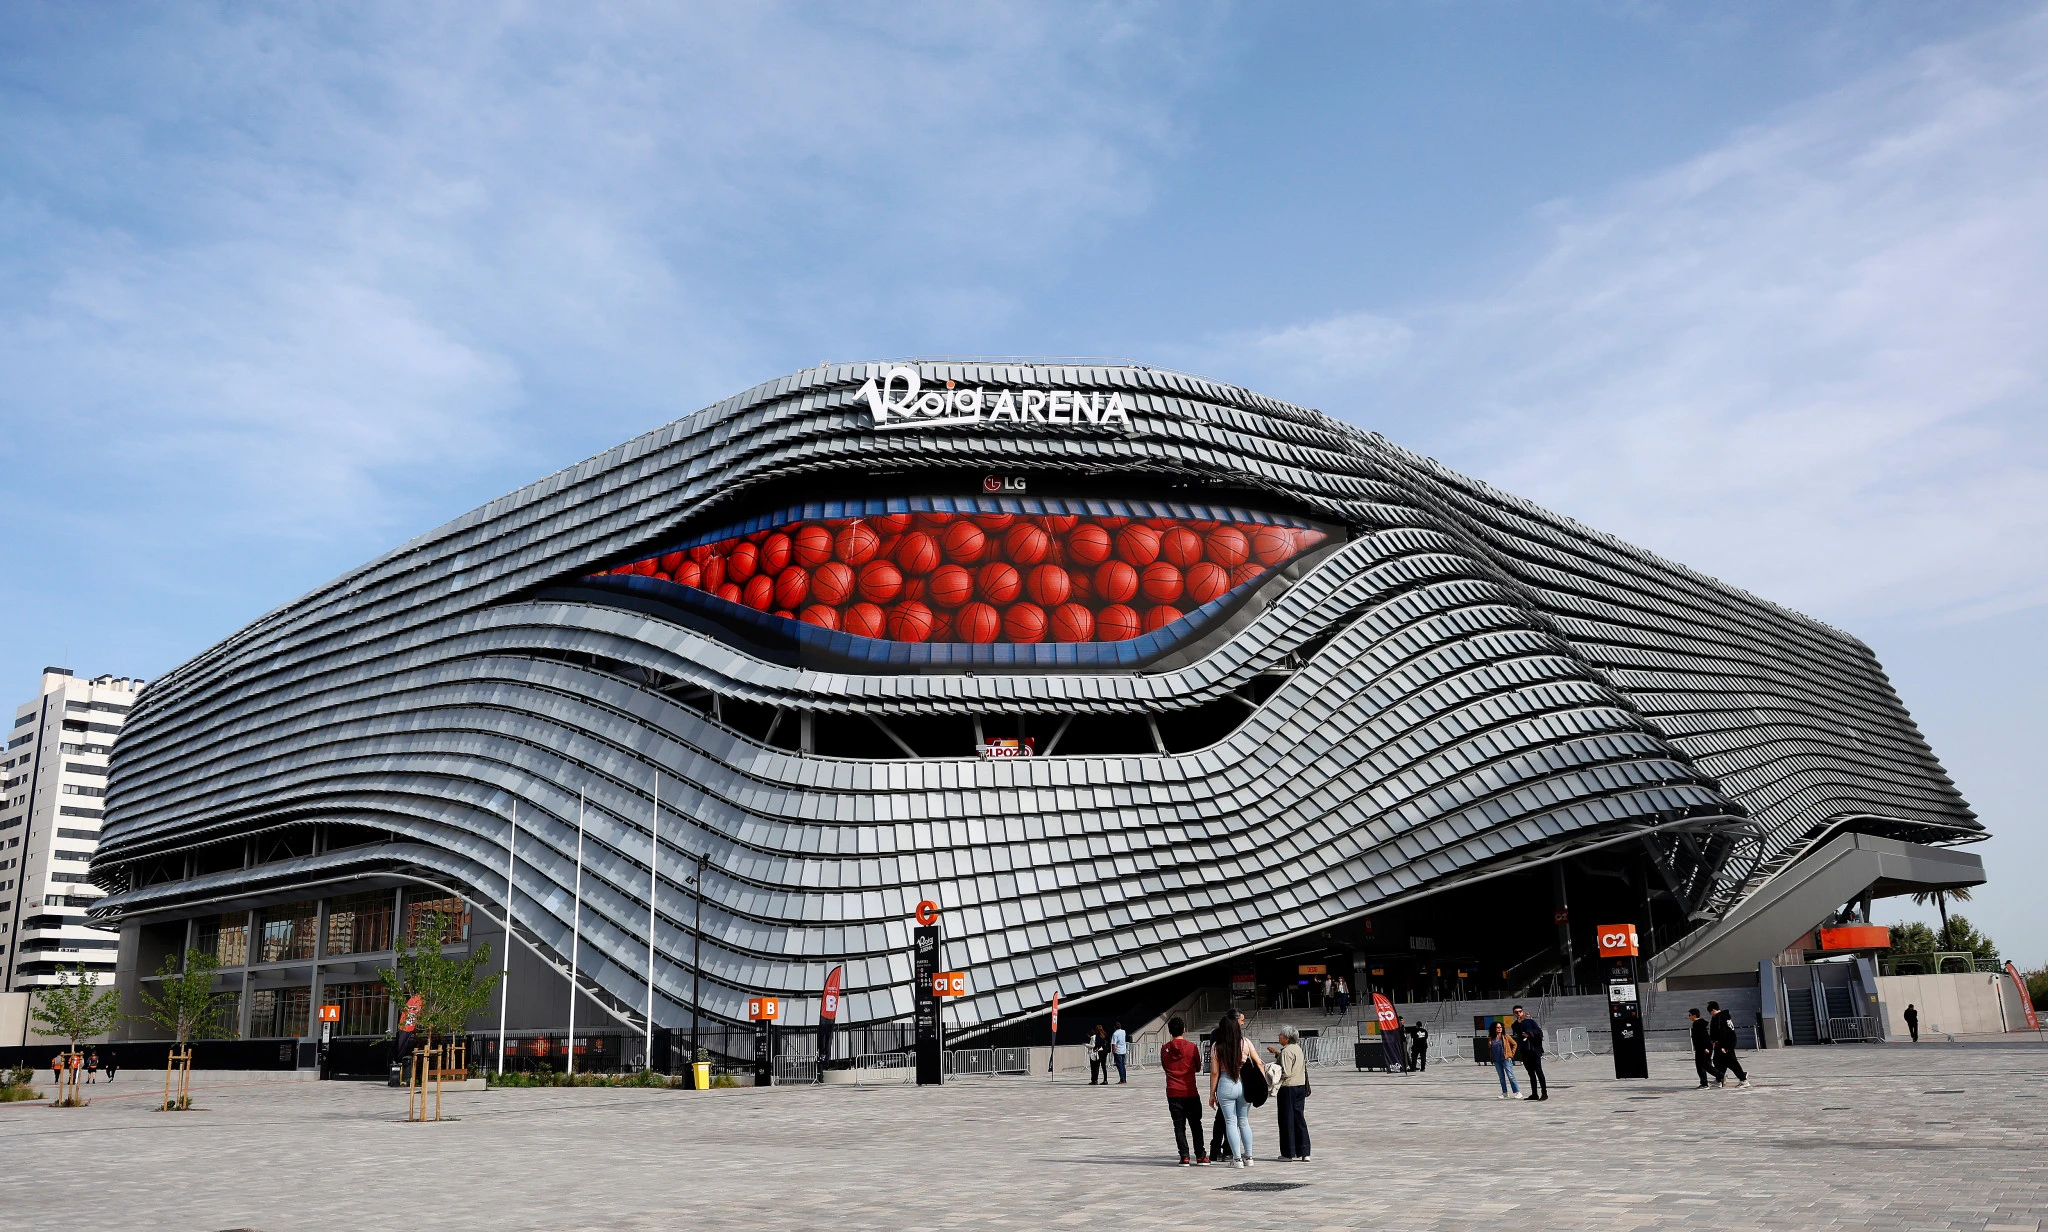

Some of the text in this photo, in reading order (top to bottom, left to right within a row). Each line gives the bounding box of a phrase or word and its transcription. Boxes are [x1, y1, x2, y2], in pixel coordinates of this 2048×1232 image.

[852, 366, 1130, 430] Roig ARENA
[1004, 476, 1026, 490] LG
[1555, 913, 1568, 921] C2
[1602, 932, 1627, 948] C2
[934, 978, 948, 991] C1
[952, 978, 964, 991] C1
[751, 1002, 760, 1015] B
[766, 1002, 775, 1015] B
[826, 995, 837, 1012] B
[318, 1008, 324, 1018] A
[329, 1008, 336, 1018] A
